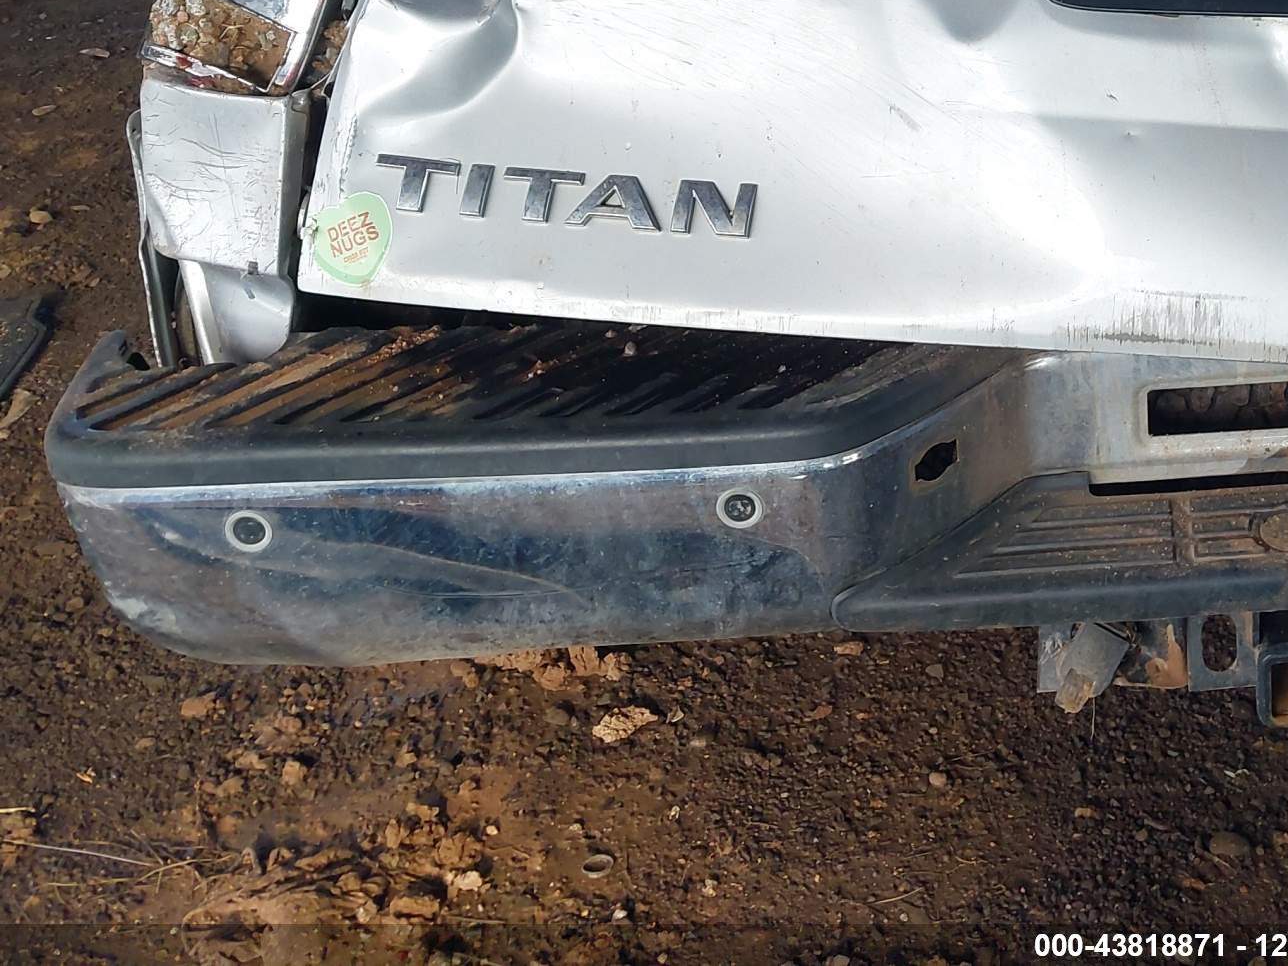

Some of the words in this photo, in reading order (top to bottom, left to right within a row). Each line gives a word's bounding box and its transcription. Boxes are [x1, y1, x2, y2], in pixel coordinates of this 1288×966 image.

[376, 154, 759, 240] TITAN
[327, 211, 373, 243] DEEZ
[330, 225, 379, 258] NUGS
